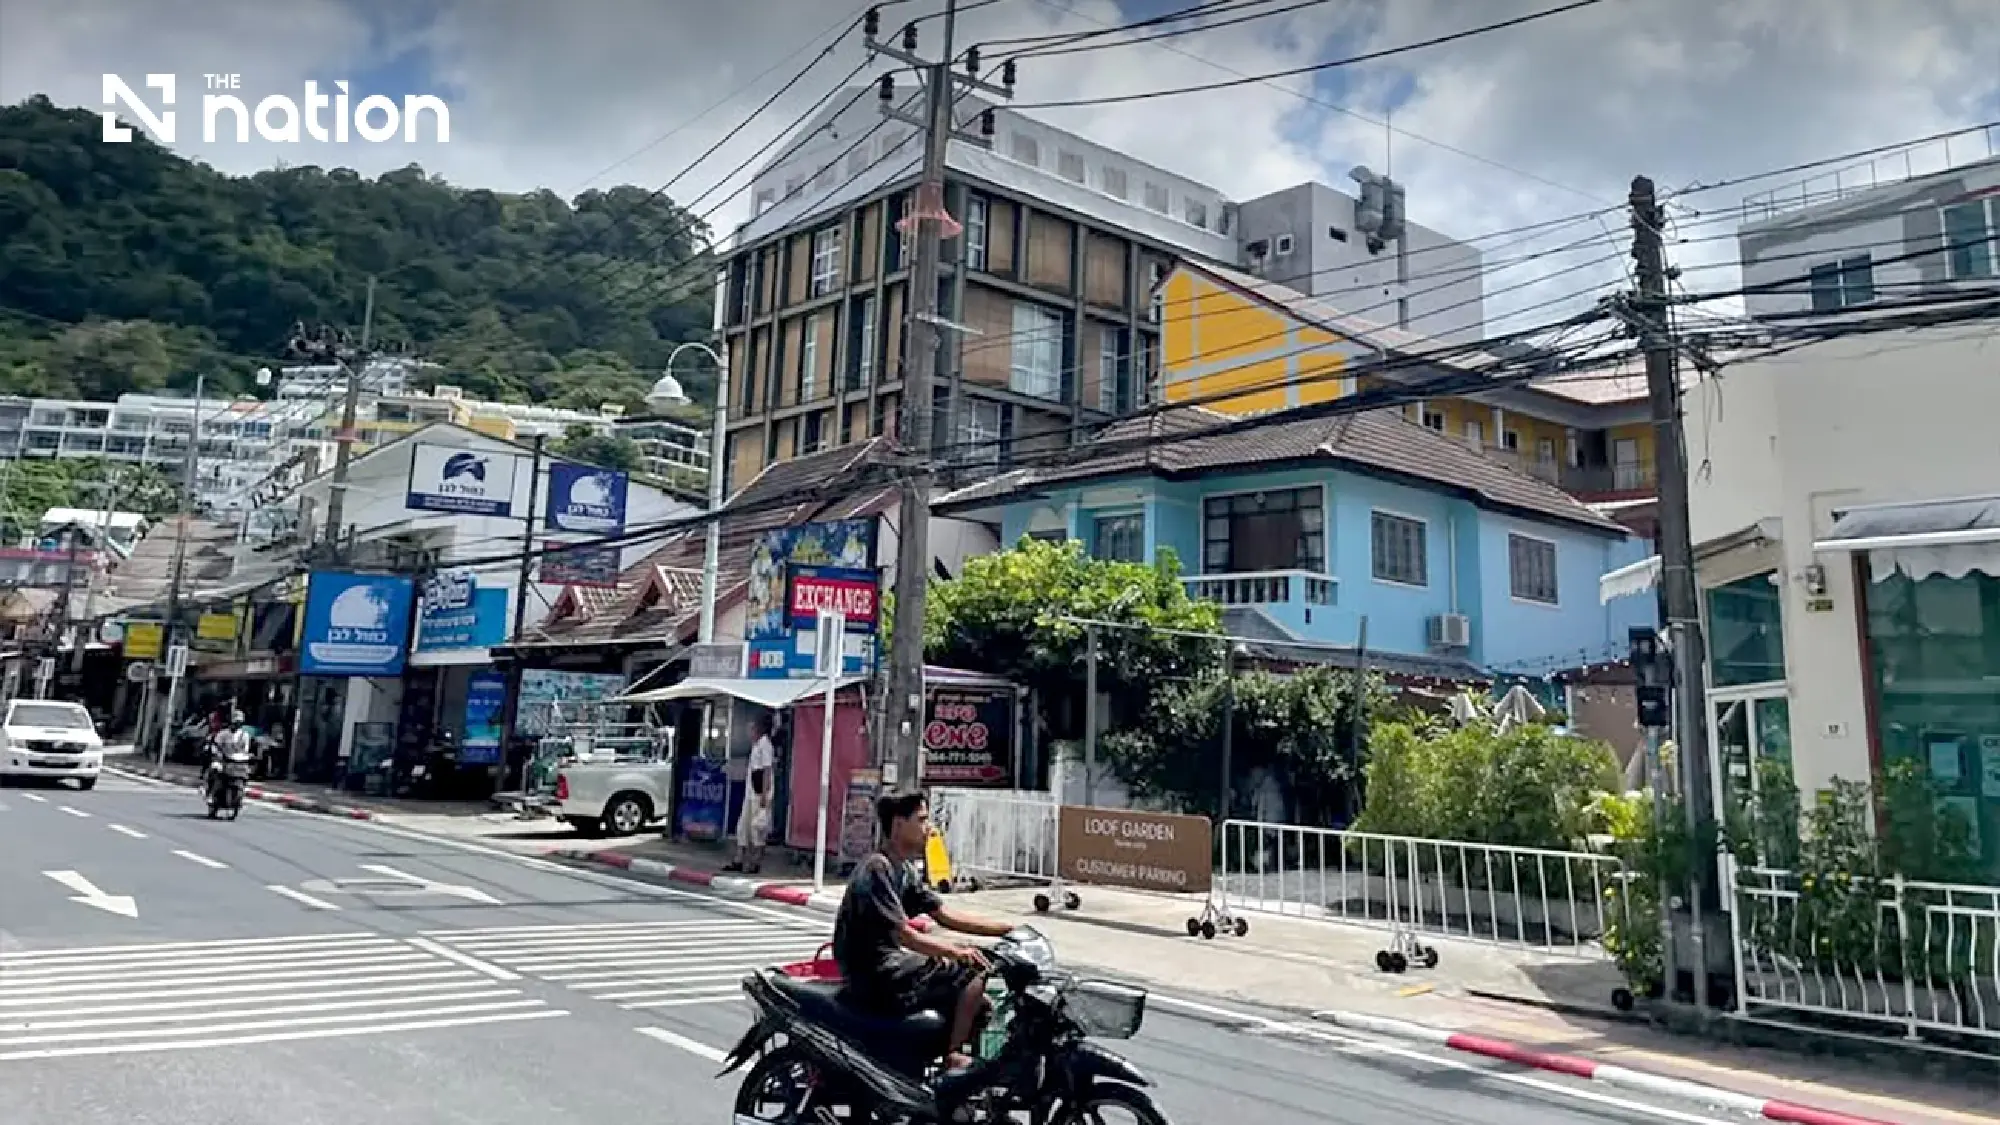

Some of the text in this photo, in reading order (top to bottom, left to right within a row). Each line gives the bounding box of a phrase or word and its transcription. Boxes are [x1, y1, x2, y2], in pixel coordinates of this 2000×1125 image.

[794, 584, 873, 615] EXCHANGE
[1084, 816, 1175, 840] LOOF GARDEN
[1076, 857, 1187, 886] CUSTOMER PARKING
